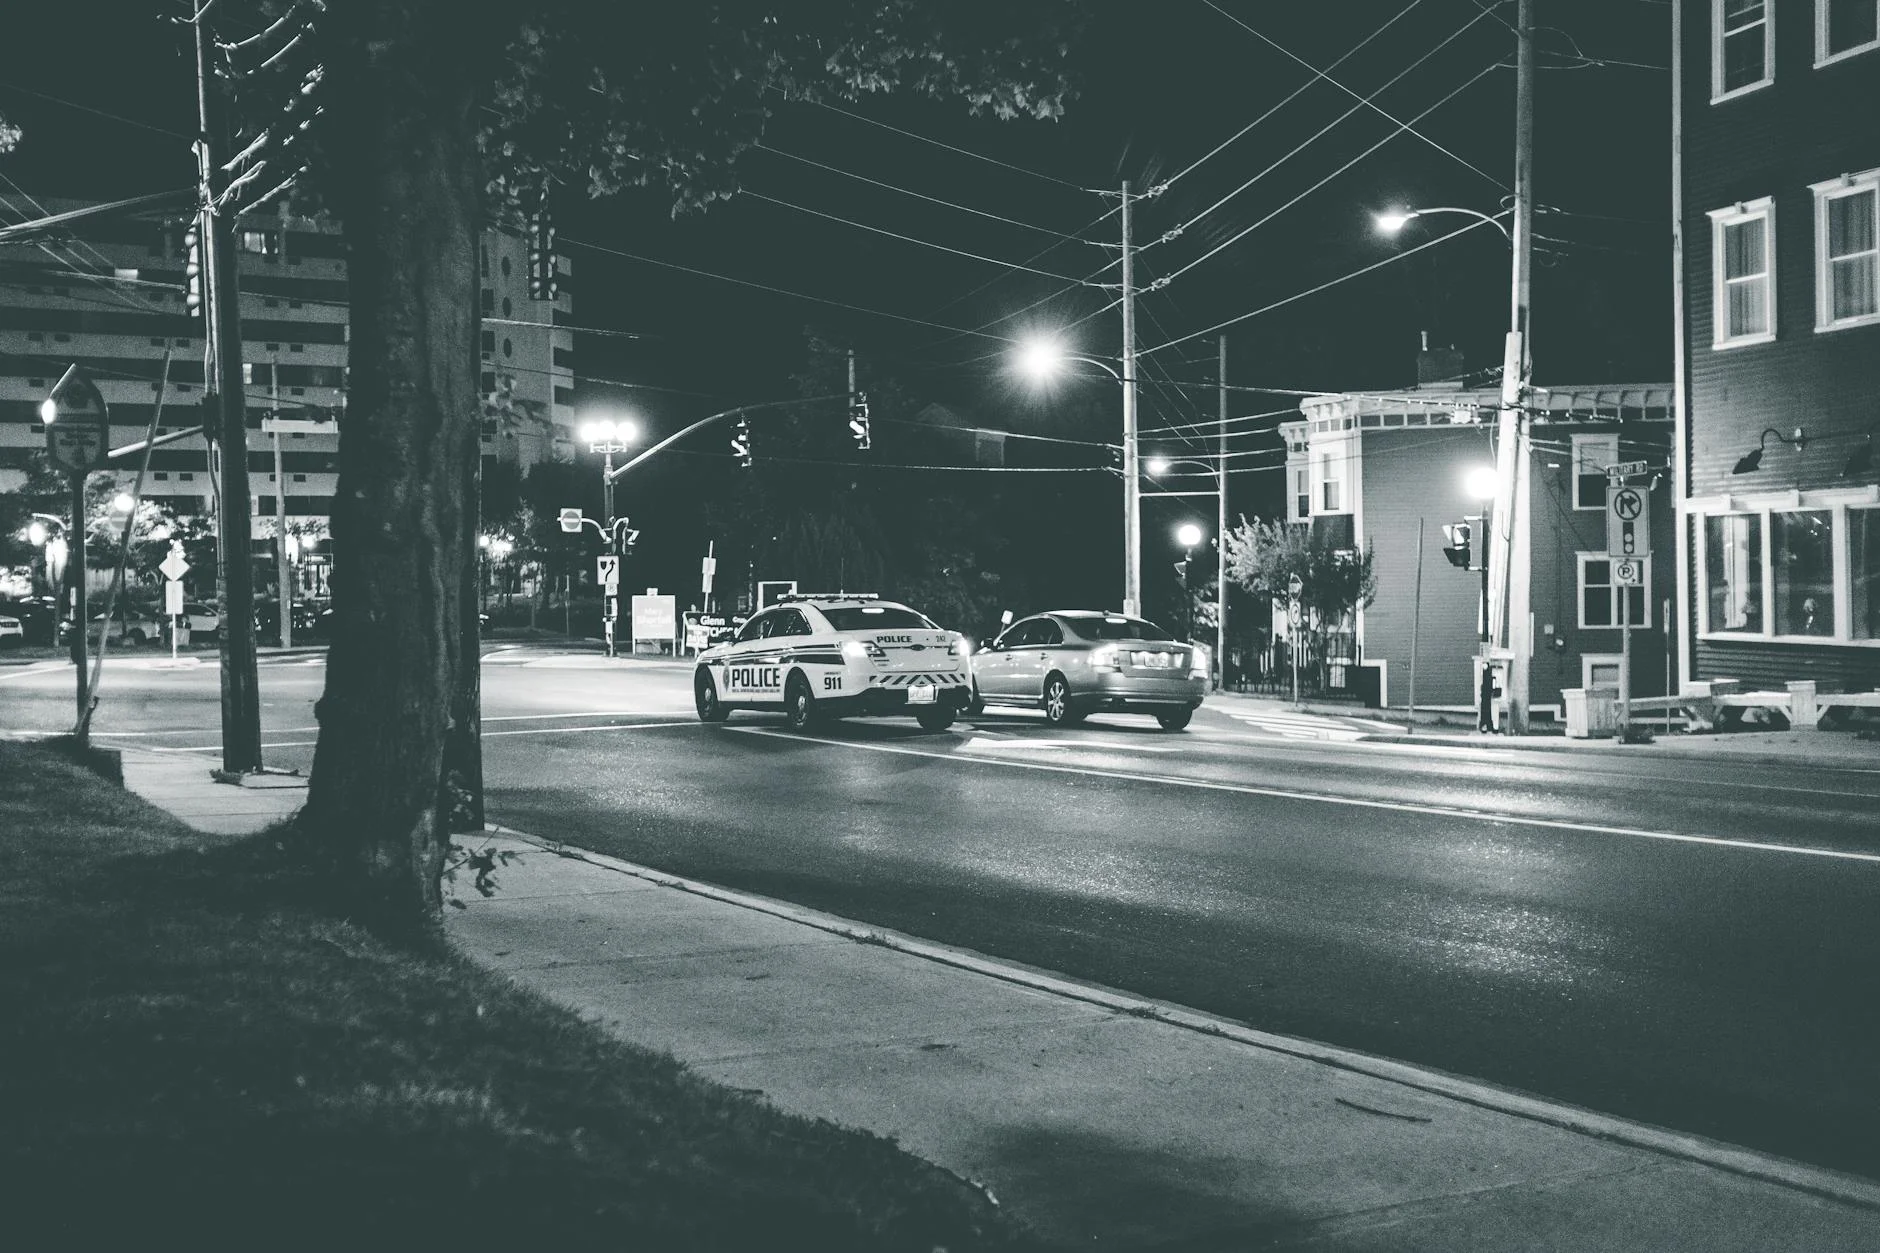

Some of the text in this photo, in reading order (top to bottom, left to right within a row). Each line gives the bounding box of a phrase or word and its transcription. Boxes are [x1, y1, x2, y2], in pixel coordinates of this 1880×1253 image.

[700, 615, 725, 626] Glenn
[876, 635, 913, 643] POLICE
[732, 668, 780, 687] POLICE
[824, 677, 842, 690] 911
